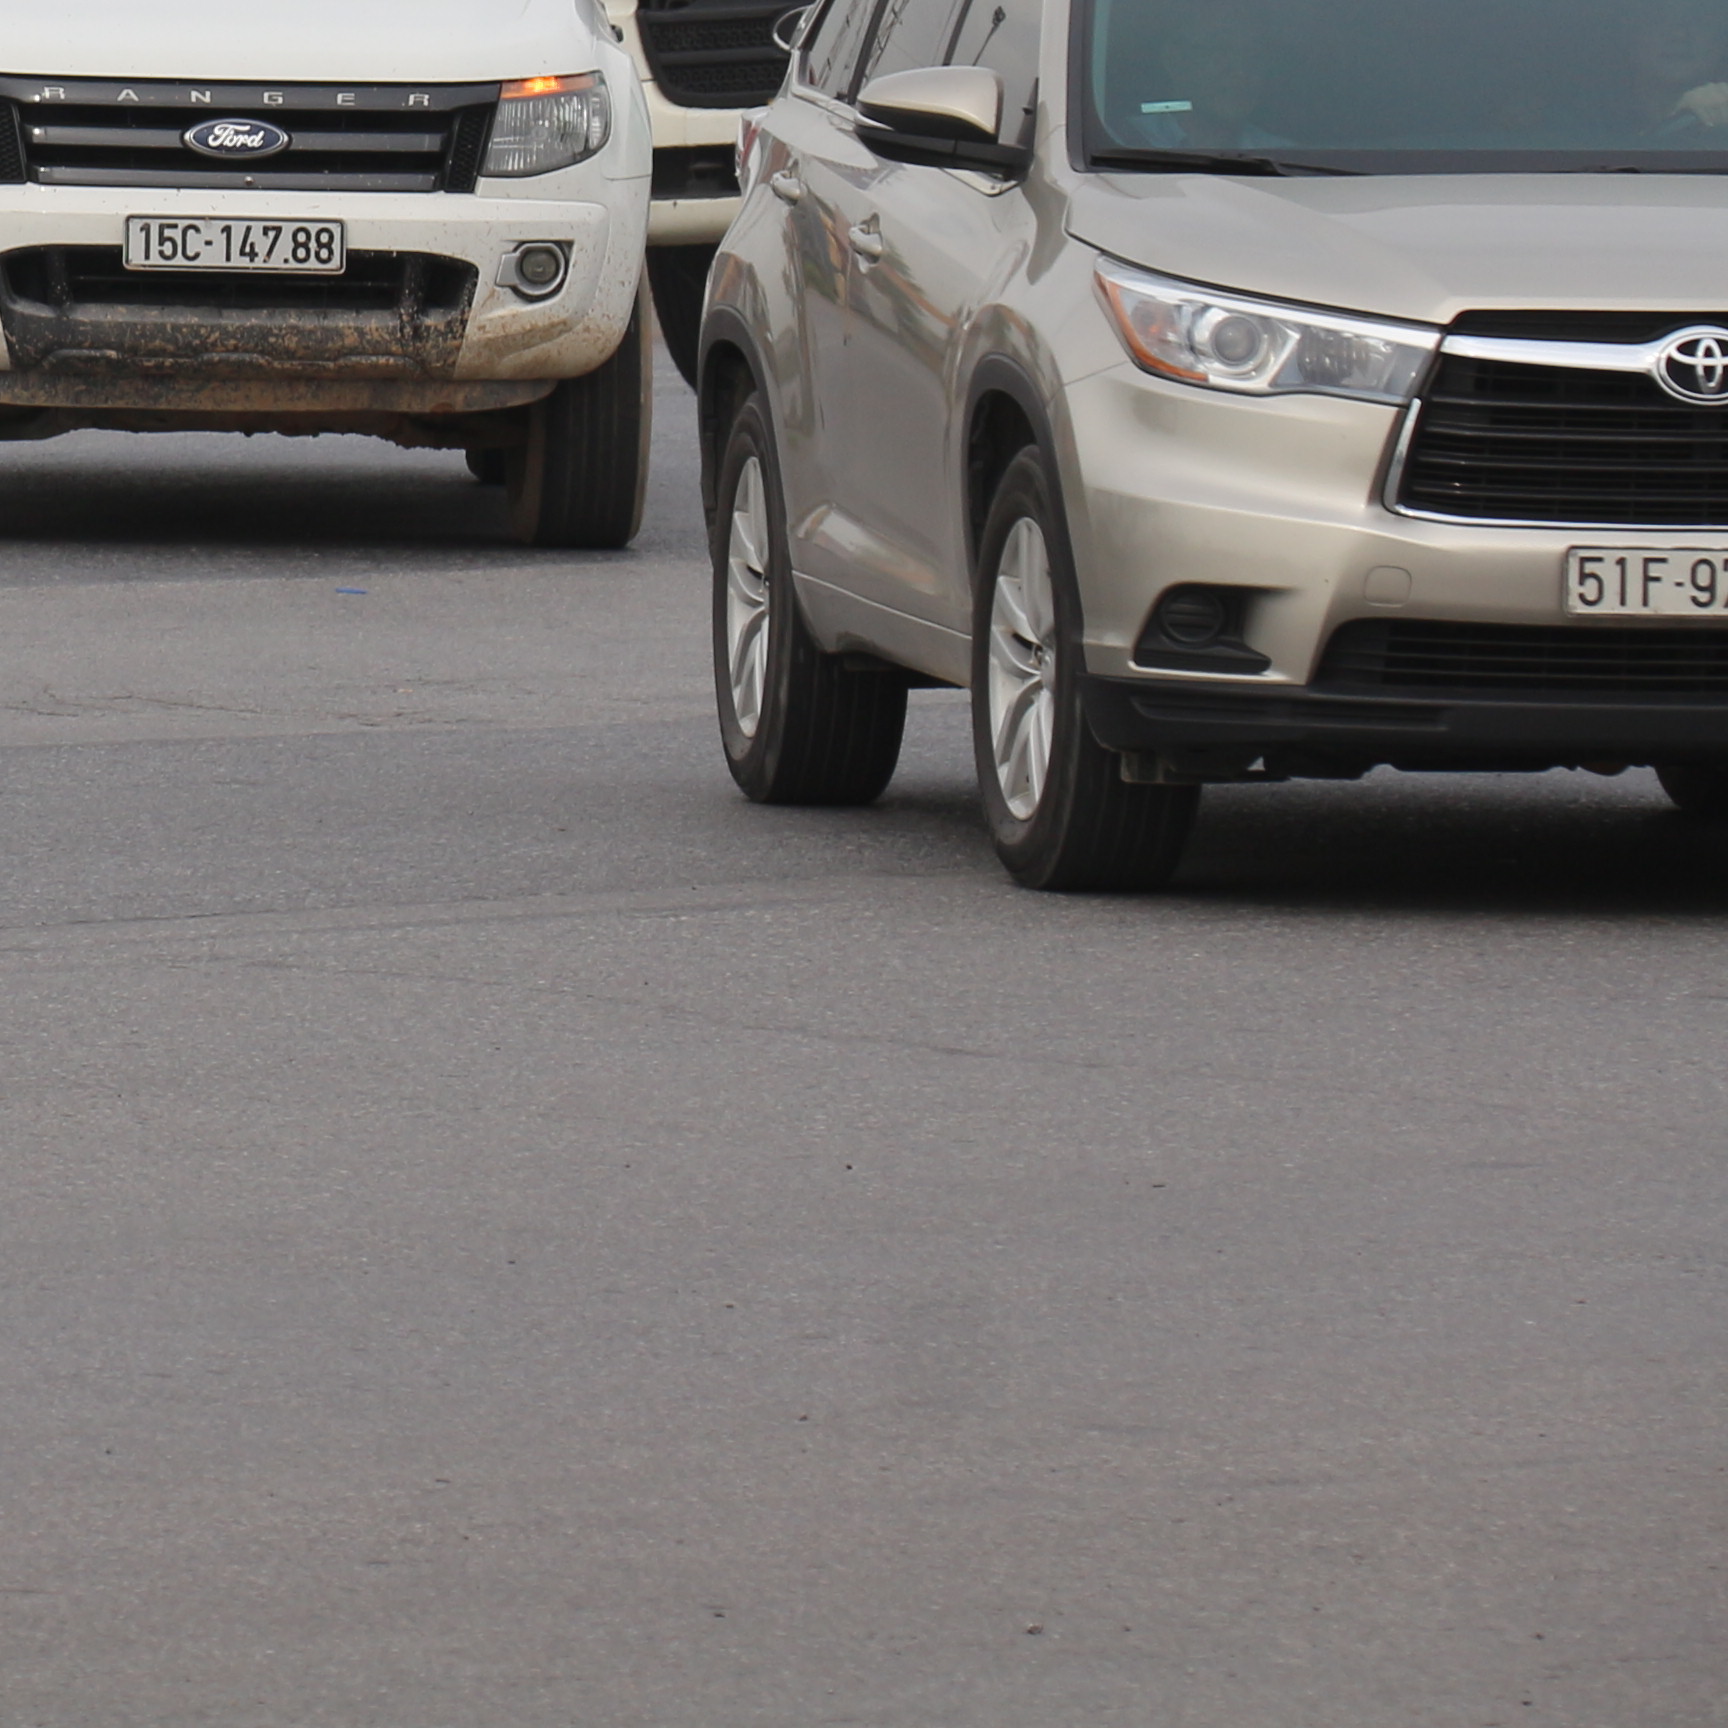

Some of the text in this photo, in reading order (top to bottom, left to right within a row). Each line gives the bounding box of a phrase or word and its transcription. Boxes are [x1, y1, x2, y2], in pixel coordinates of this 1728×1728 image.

[44, 86, 431, 107] RANGER
[208, 124, 264, 149] Ford
[139, 223, 335, 265] 15C-147.88
[1578, 557, 1728, 608] 51F-9
